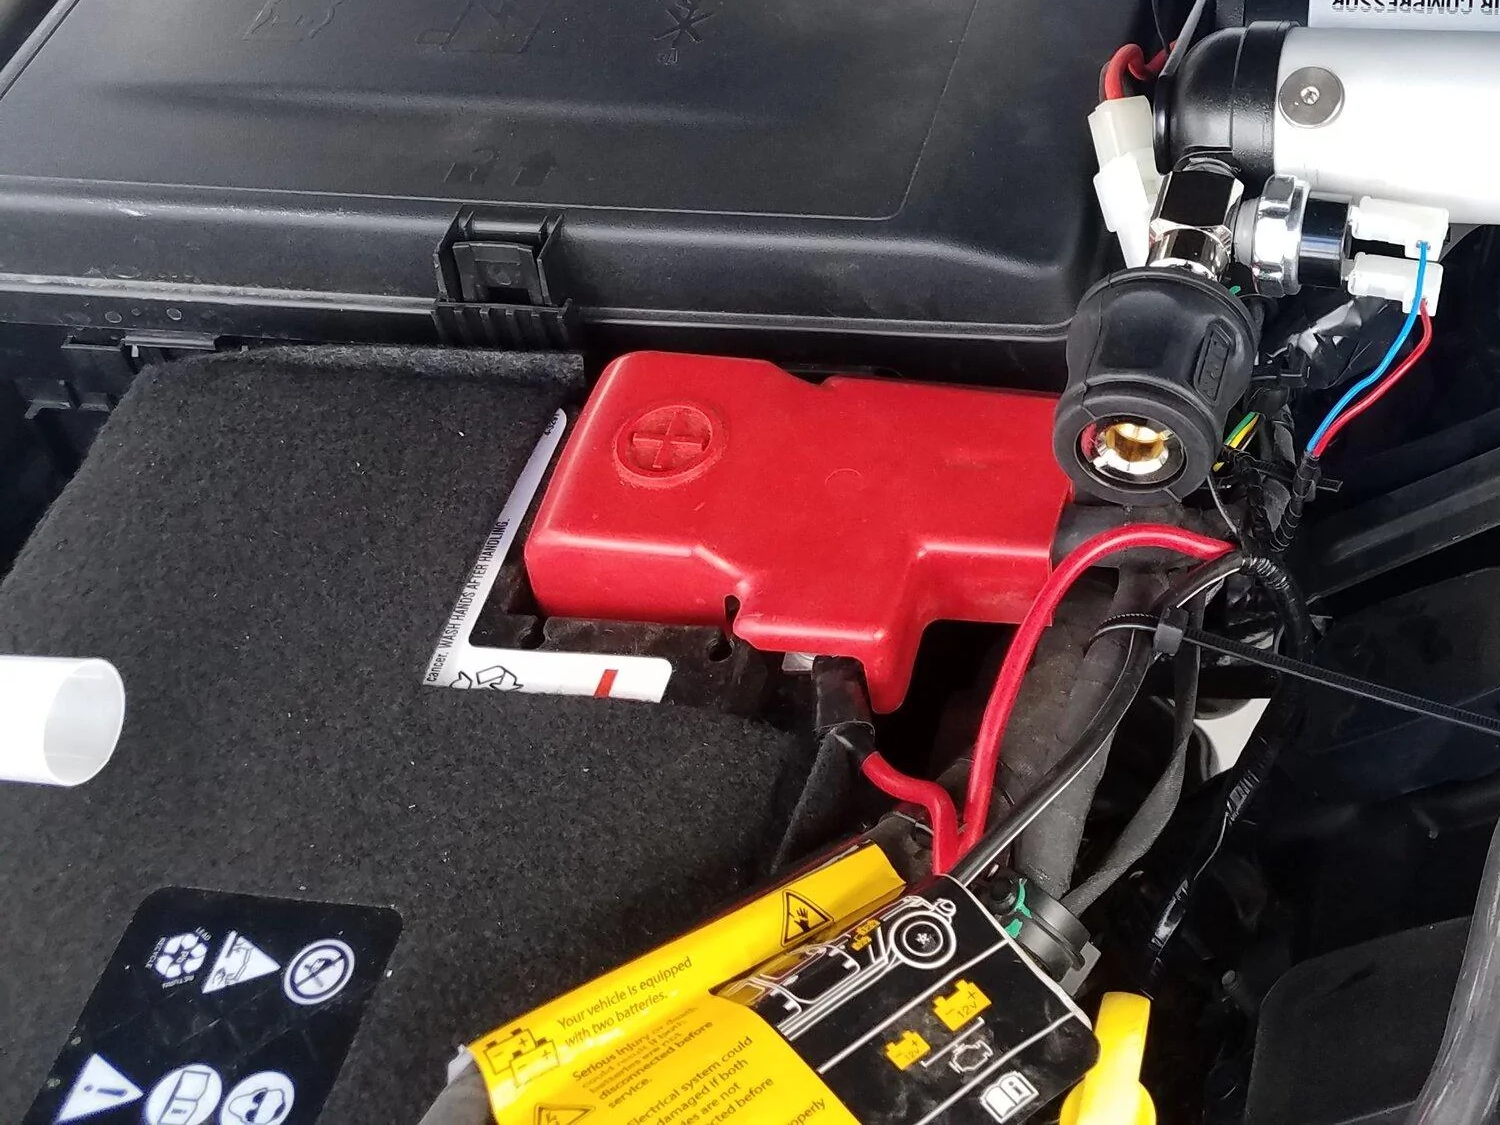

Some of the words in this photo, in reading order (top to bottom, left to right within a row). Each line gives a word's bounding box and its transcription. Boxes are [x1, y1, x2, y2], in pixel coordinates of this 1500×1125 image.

[427, 651, 449, 682] cancer.
[438, 623, 461, 649] WASH
[451, 590, 476, 620] HANDS
[468, 563, 489, 590] AFTER
[479, 518, 510, 562] HANDLING.
[557, 1010, 586, 1030] Your
[587, 991, 627, 1017] vehicle
[627, 985, 638, 998] is
[639, 956, 693, 991] equipped
[565, 1027, 591, 1047] with
[592, 1016, 614, 1035] two
[615, 991, 668, 1023] batteries.
[573, 1054, 617, 1082] Serious
[599, 1046, 676, 1100] disconnected
[674, 1021, 713, 1048] before
[680, 1061, 721, 1092] system
[721, 1035, 753, 1063] could
[718, 1059, 748, 1082] both
[608, 1078, 653, 1109] service.
[700, 1099, 720, 1115] are
[720, 1082, 742, 1101] not
[734, 1077, 775, 1108] before
